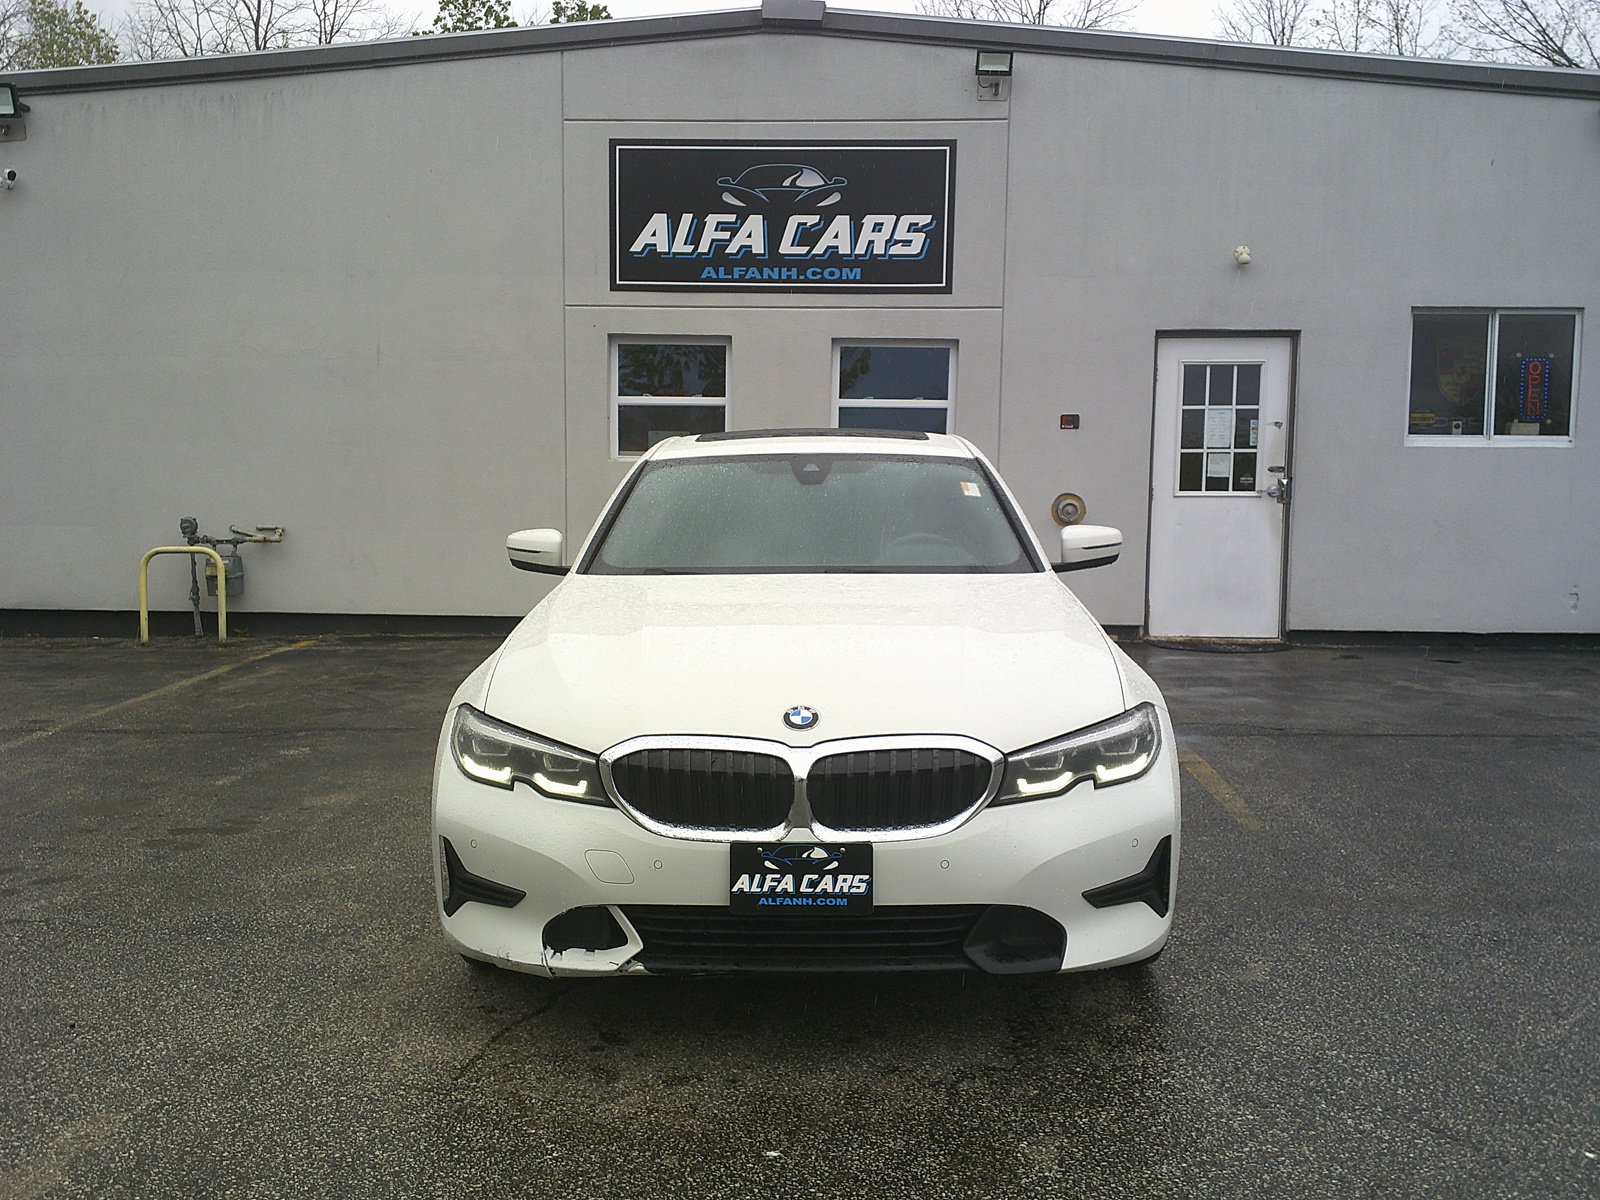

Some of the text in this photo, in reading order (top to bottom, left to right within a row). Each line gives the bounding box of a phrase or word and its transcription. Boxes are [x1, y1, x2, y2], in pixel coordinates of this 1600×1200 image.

[629, 213, 936, 260] ALFA CARS
[700, 267, 862, 280] ALFANH.COM
[731, 874, 872, 895] ALFA CARS
[758, 898, 848, 906] ALFANH.COM
